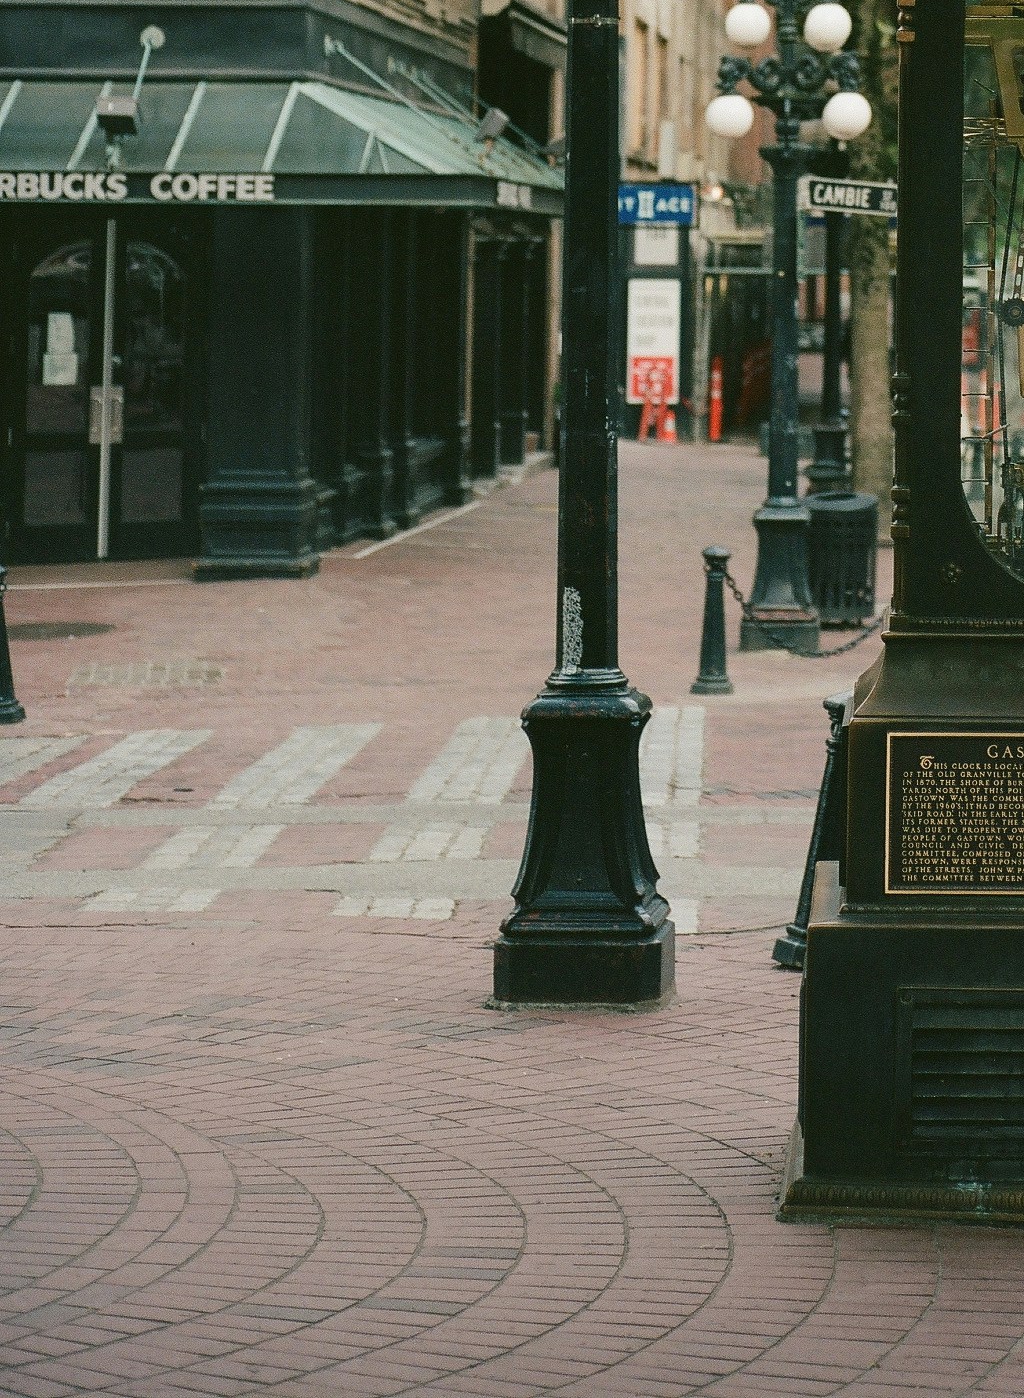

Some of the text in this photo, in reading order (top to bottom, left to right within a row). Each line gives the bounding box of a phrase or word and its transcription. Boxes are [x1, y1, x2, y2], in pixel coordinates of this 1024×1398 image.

[150, 173, 275, 201] COFFEE
[813, 183, 872, 209] CAMBIE
[919, 755, 947, 769] THIS
